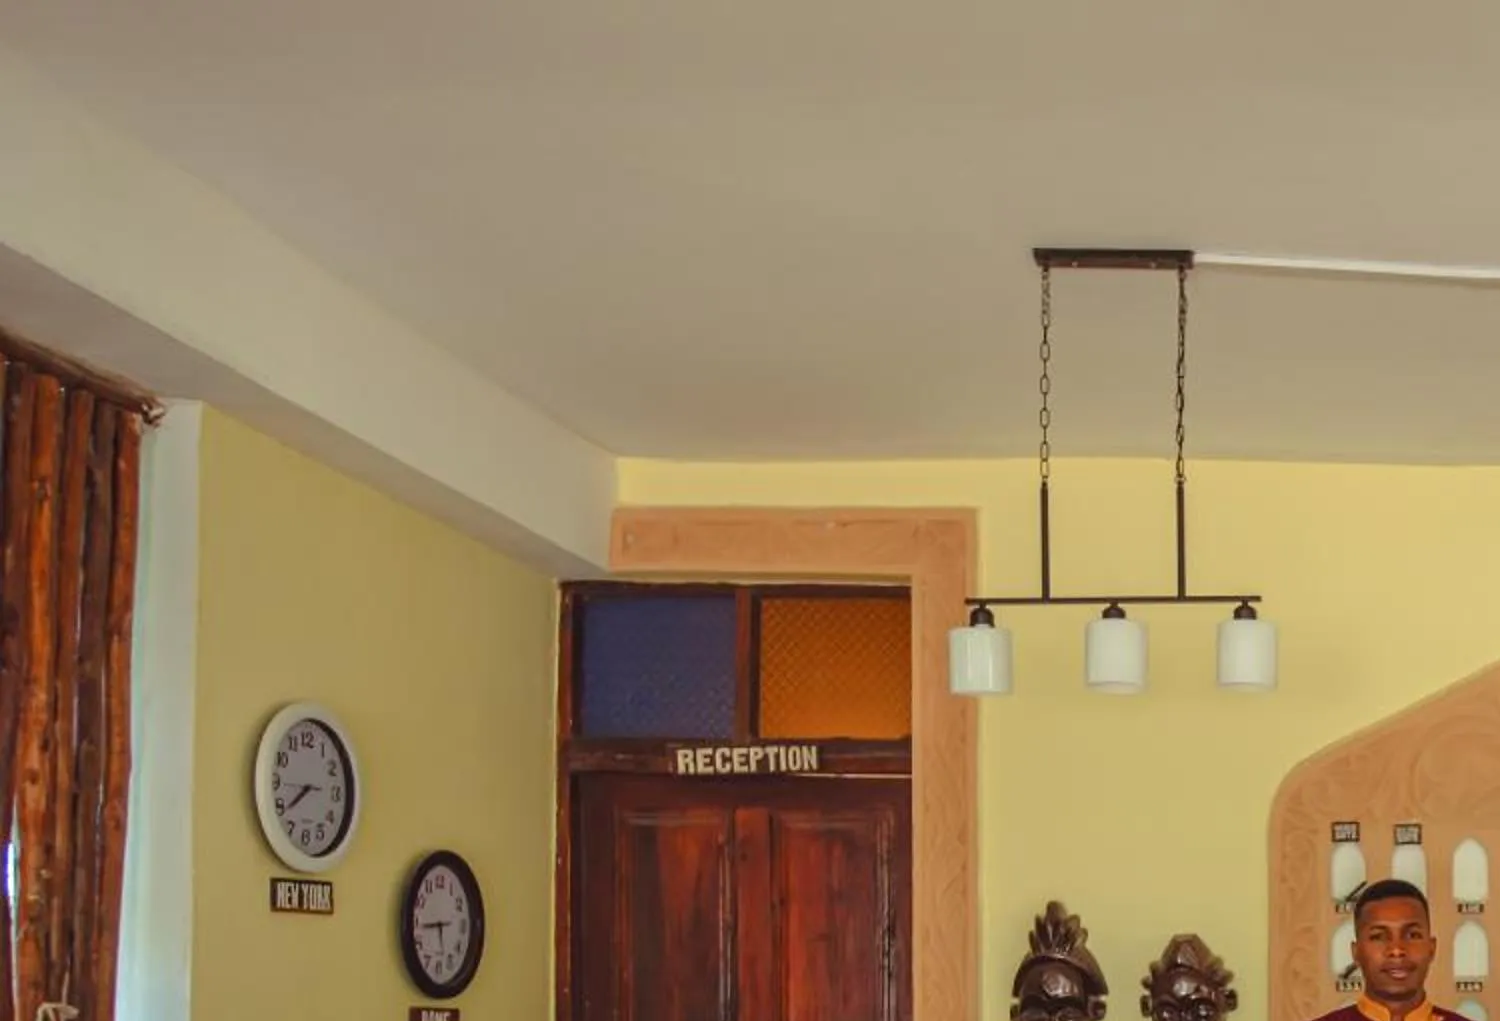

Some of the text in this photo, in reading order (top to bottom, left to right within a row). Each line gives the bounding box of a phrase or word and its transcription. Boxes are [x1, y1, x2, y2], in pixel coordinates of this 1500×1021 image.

[288, 736, 298, 752] 11
[301, 732, 315, 748] 12
[274, 752, 289, 768] 10
[328, 760, 337, 776] 2
[677, 745, 819, 775] RECEPTION
[302, 829, 311, 846] 6
[276, 882, 332, 911] NEW YORK
